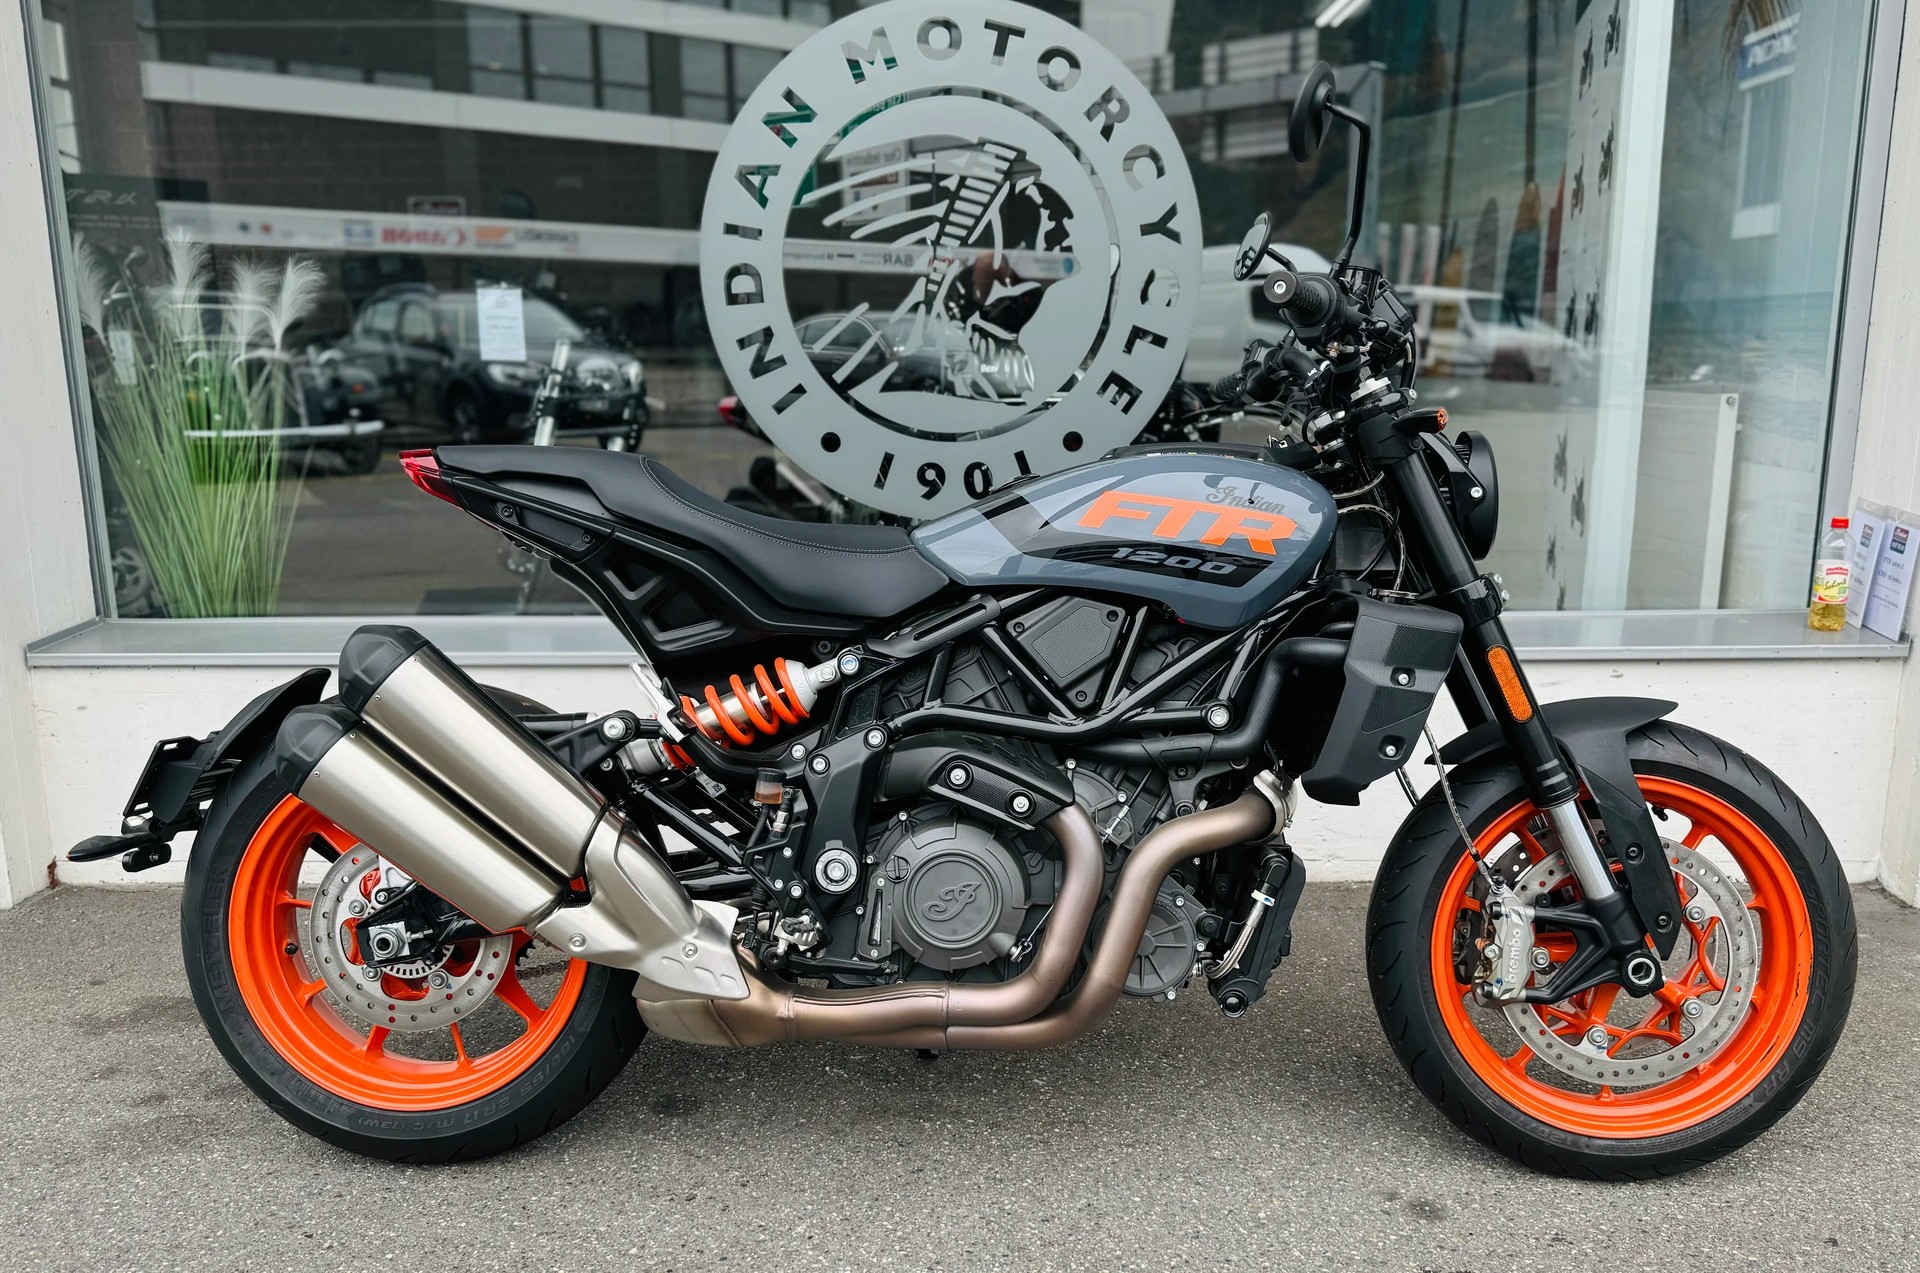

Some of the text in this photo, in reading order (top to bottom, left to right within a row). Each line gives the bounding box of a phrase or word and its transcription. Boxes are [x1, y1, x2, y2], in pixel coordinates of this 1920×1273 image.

[723, 16, 1182, 415] INDIAN MOTORCYCLE
[874, 449, 1032, 501] 1901
[1206, 486, 1285, 515] Indian
[1077, 490, 1298, 556] FTR
[1111, 547, 1238, 575] 1200
[1504, 928, 1522, 983] brembo
[1806, 884, 1832, 1013] SPORTEC
